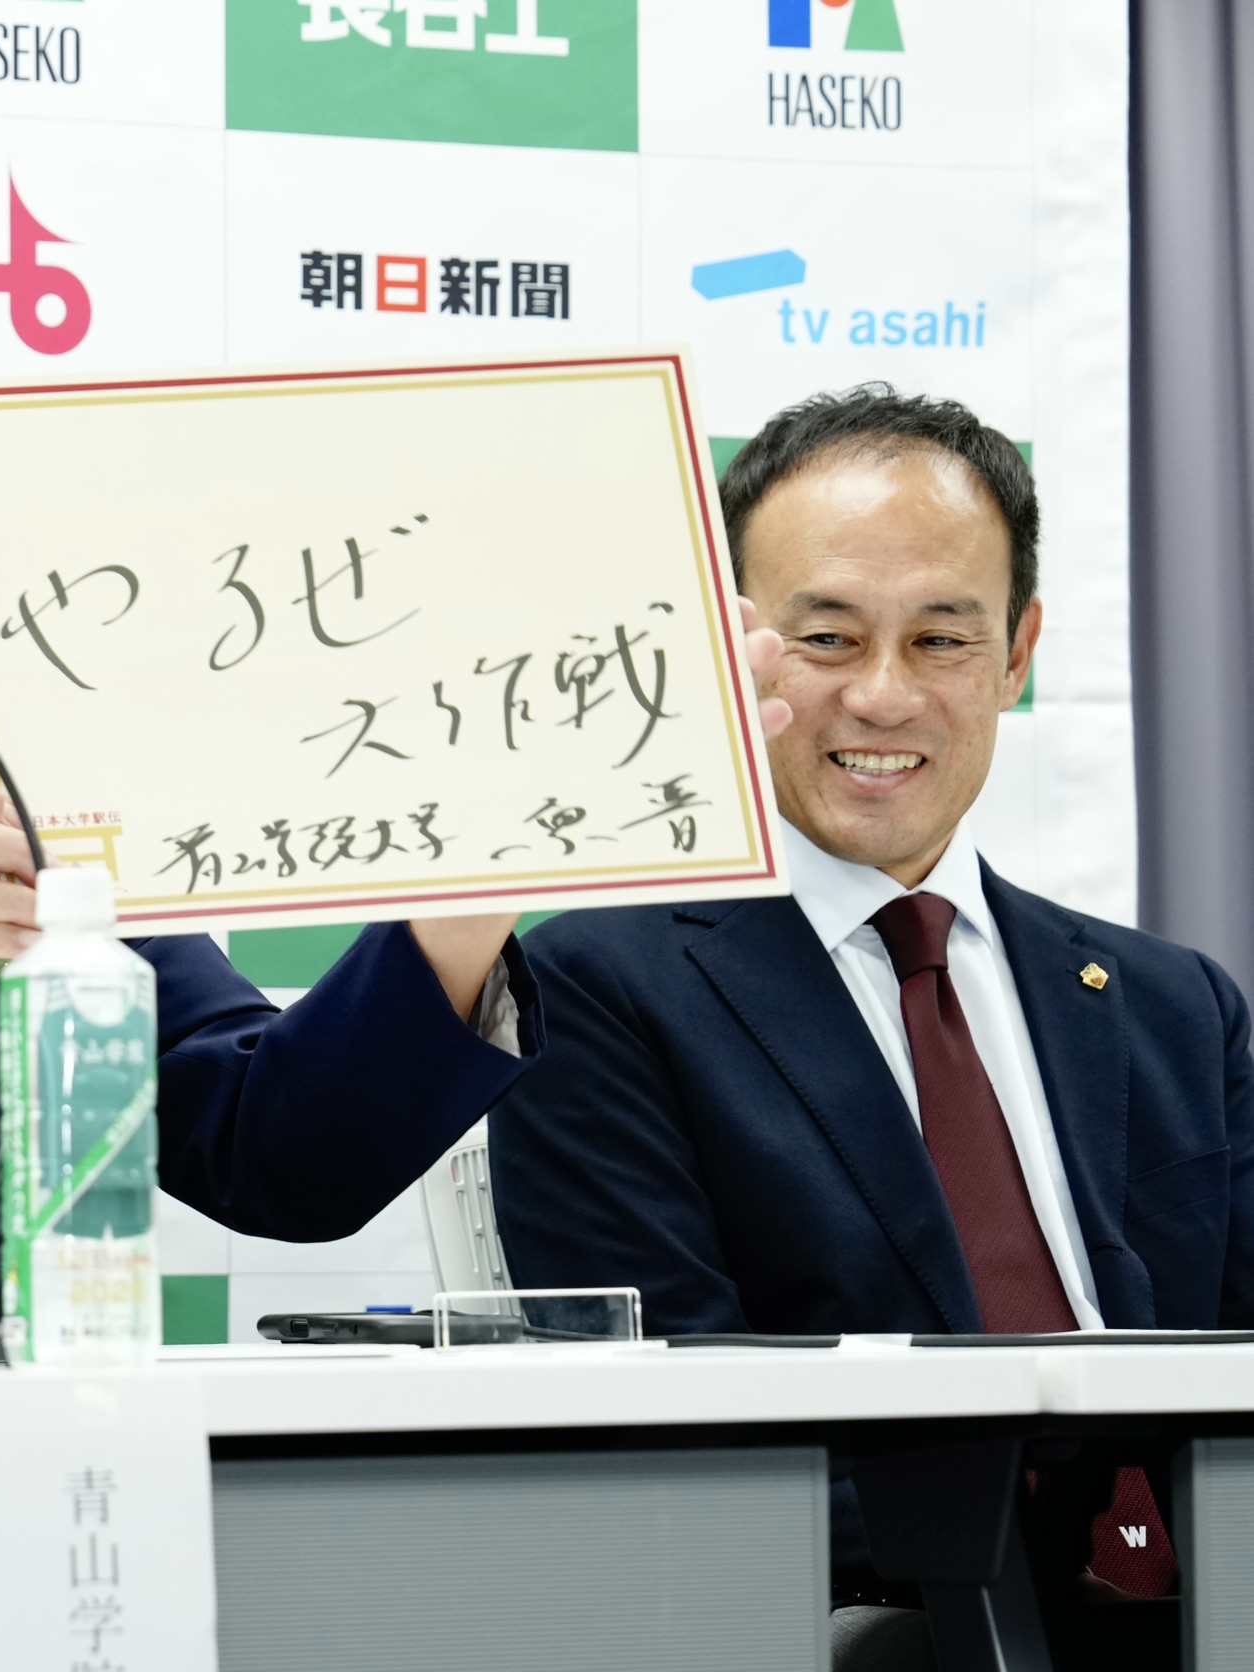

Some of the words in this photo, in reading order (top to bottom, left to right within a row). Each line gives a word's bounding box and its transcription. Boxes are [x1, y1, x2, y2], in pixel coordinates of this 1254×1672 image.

[767, 72, 902, 132] HASEKO
[300, 250, 571, 320] 朝日新聞
[777, 299, 830, 345] tv
[848, 301, 987, 349] asahi
[0, 513, 430, 691] やるぜ
[65, 1465, 125, 1672] 青山学
[1118, 1525, 1147, 1548] W
